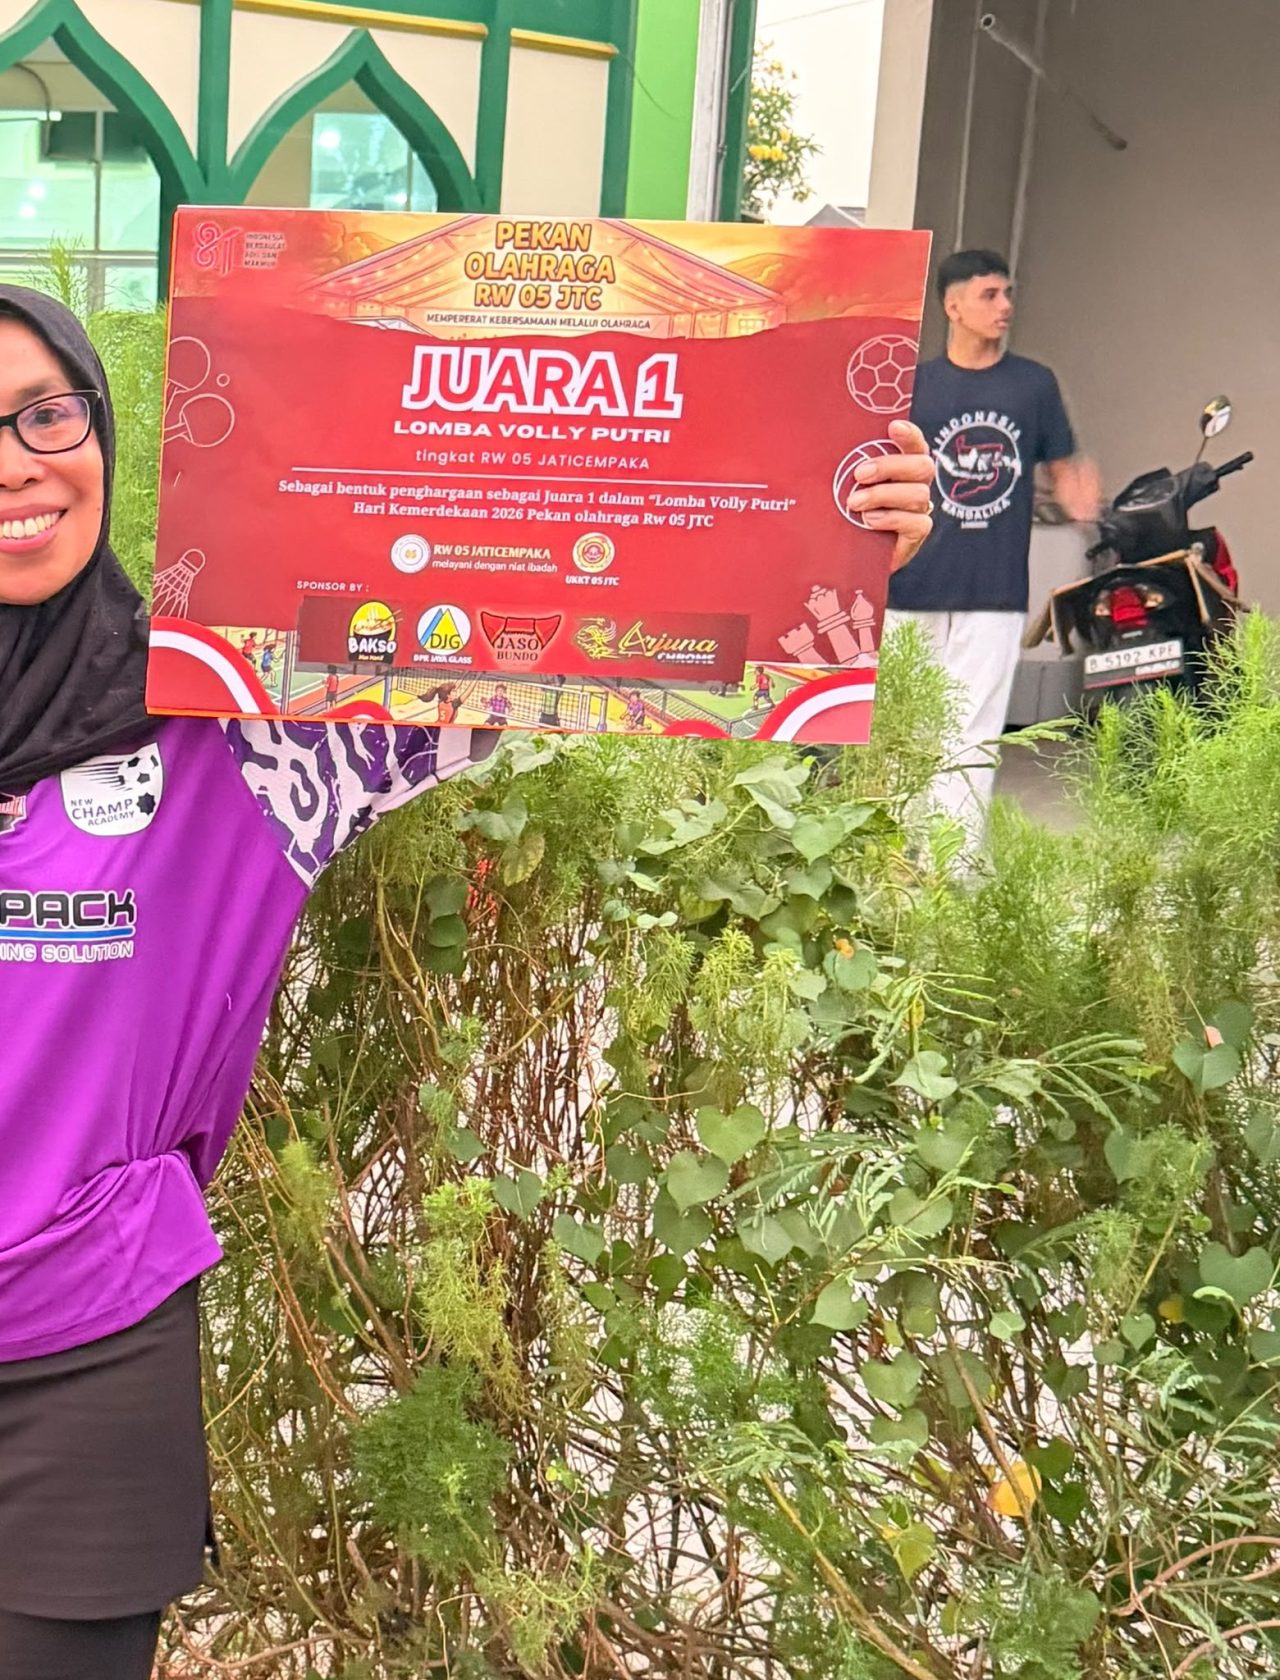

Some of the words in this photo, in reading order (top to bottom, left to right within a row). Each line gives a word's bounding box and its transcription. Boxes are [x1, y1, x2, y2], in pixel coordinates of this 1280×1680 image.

[496, 221, 592, 251] PEKAN
[465, 252, 616, 283] OLAHRAGA
[475, 283, 516, 307] RW
[520, 285, 551, 308] 05
[556, 286, 602, 311] JTC
[426, 313, 487, 324] MEMPERERAT
[489, 315, 557, 327] KEBERSAMAAN
[560, 317, 598, 328] MELALUI
[600, 318, 651, 330] OLAHRAGA
[401, 345, 629, 417] JUARA
[633, 352, 683, 419] 1
[394, 420, 492, 437] LOMBA
[499, 423, 586, 441] VOLLY
[591, 427, 671, 444] PUTRI
[934, 411, 1021, 444] INDONESIA
[416, 449, 475, 466] tingkat
[481, 452, 506, 465] RW
[512, 453, 532, 465] 05
[538, 454, 650, 470] JATICEMPAKA
[278, 479, 333, 497] Sebagai
[336, 481, 387, 496] bentuk
[389, 484, 483, 501] penghargaan
[486, 485, 541, 504] sebagai
[543, 490, 583, 505] Juara
[587, 491, 595, 504] 1
[598, 492, 645, 506] dalam
[710, 496, 747, 512] Volly
[353, 502, 385, 515] Hari
[389, 503, 488, 518] Kemerdekaan
[491, 507, 524, 520] 2026
[527, 509, 571, 522] Pekan
[574, 510, 640, 527] olahraga
[643, 513, 666, 526] Rw
[669, 514, 686, 527] 05
[687, 514, 714, 530] JTC
[433, 544, 453, 555] RW
[454, 544, 470, 556] 05
[471, 545, 551, 559] JATICEMPAKA
[432, 559, 472, 571] melayani
[474, 560, 506, 572] dengan
[508, 562, 526, 572] niat
[527, 562, 558, 573] ibadah
[296, 580, 346, 591] SPONSOR
[349, 582, 363, 592] BY
[591, 575, 603, 585] 05
[603, 576, 620, 586] JTC
[348, 637, 397, 654] BAKSO
[430, 634, 460, 649] DJG
[497, 637, 539, 651] JASO
[618, 620, 719, 657] Arjuna
[448, 656, 472, 664] GLASS
[497, 651, 538, 661] BUNDO
[70, 798, 93, 807] NEW
[72, 798, 133, 820] CHAMP
[88, 810, 135, 826] ACADEMY
[42, 940, 134, 963] SOLUTION
